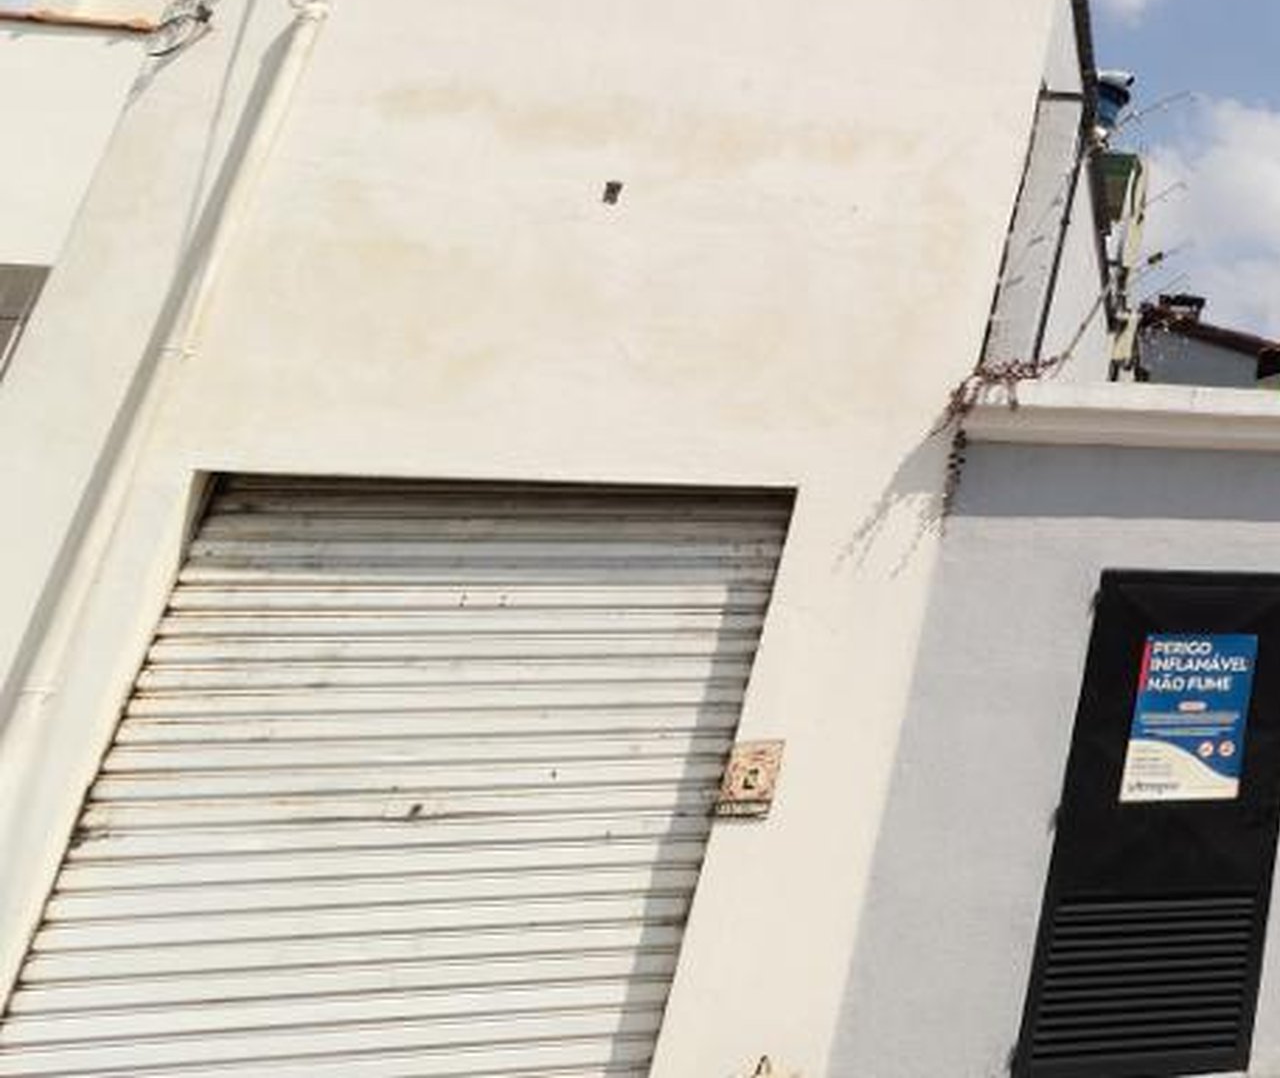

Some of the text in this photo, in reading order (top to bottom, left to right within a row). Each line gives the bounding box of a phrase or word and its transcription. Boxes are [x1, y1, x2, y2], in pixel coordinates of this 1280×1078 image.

[1153, 641, 1213, 655] PERIGO
[1149, 653, 1247, 672] INFLAMÁVEL
[1147, 673, 1232, 691] NÃO FUME
